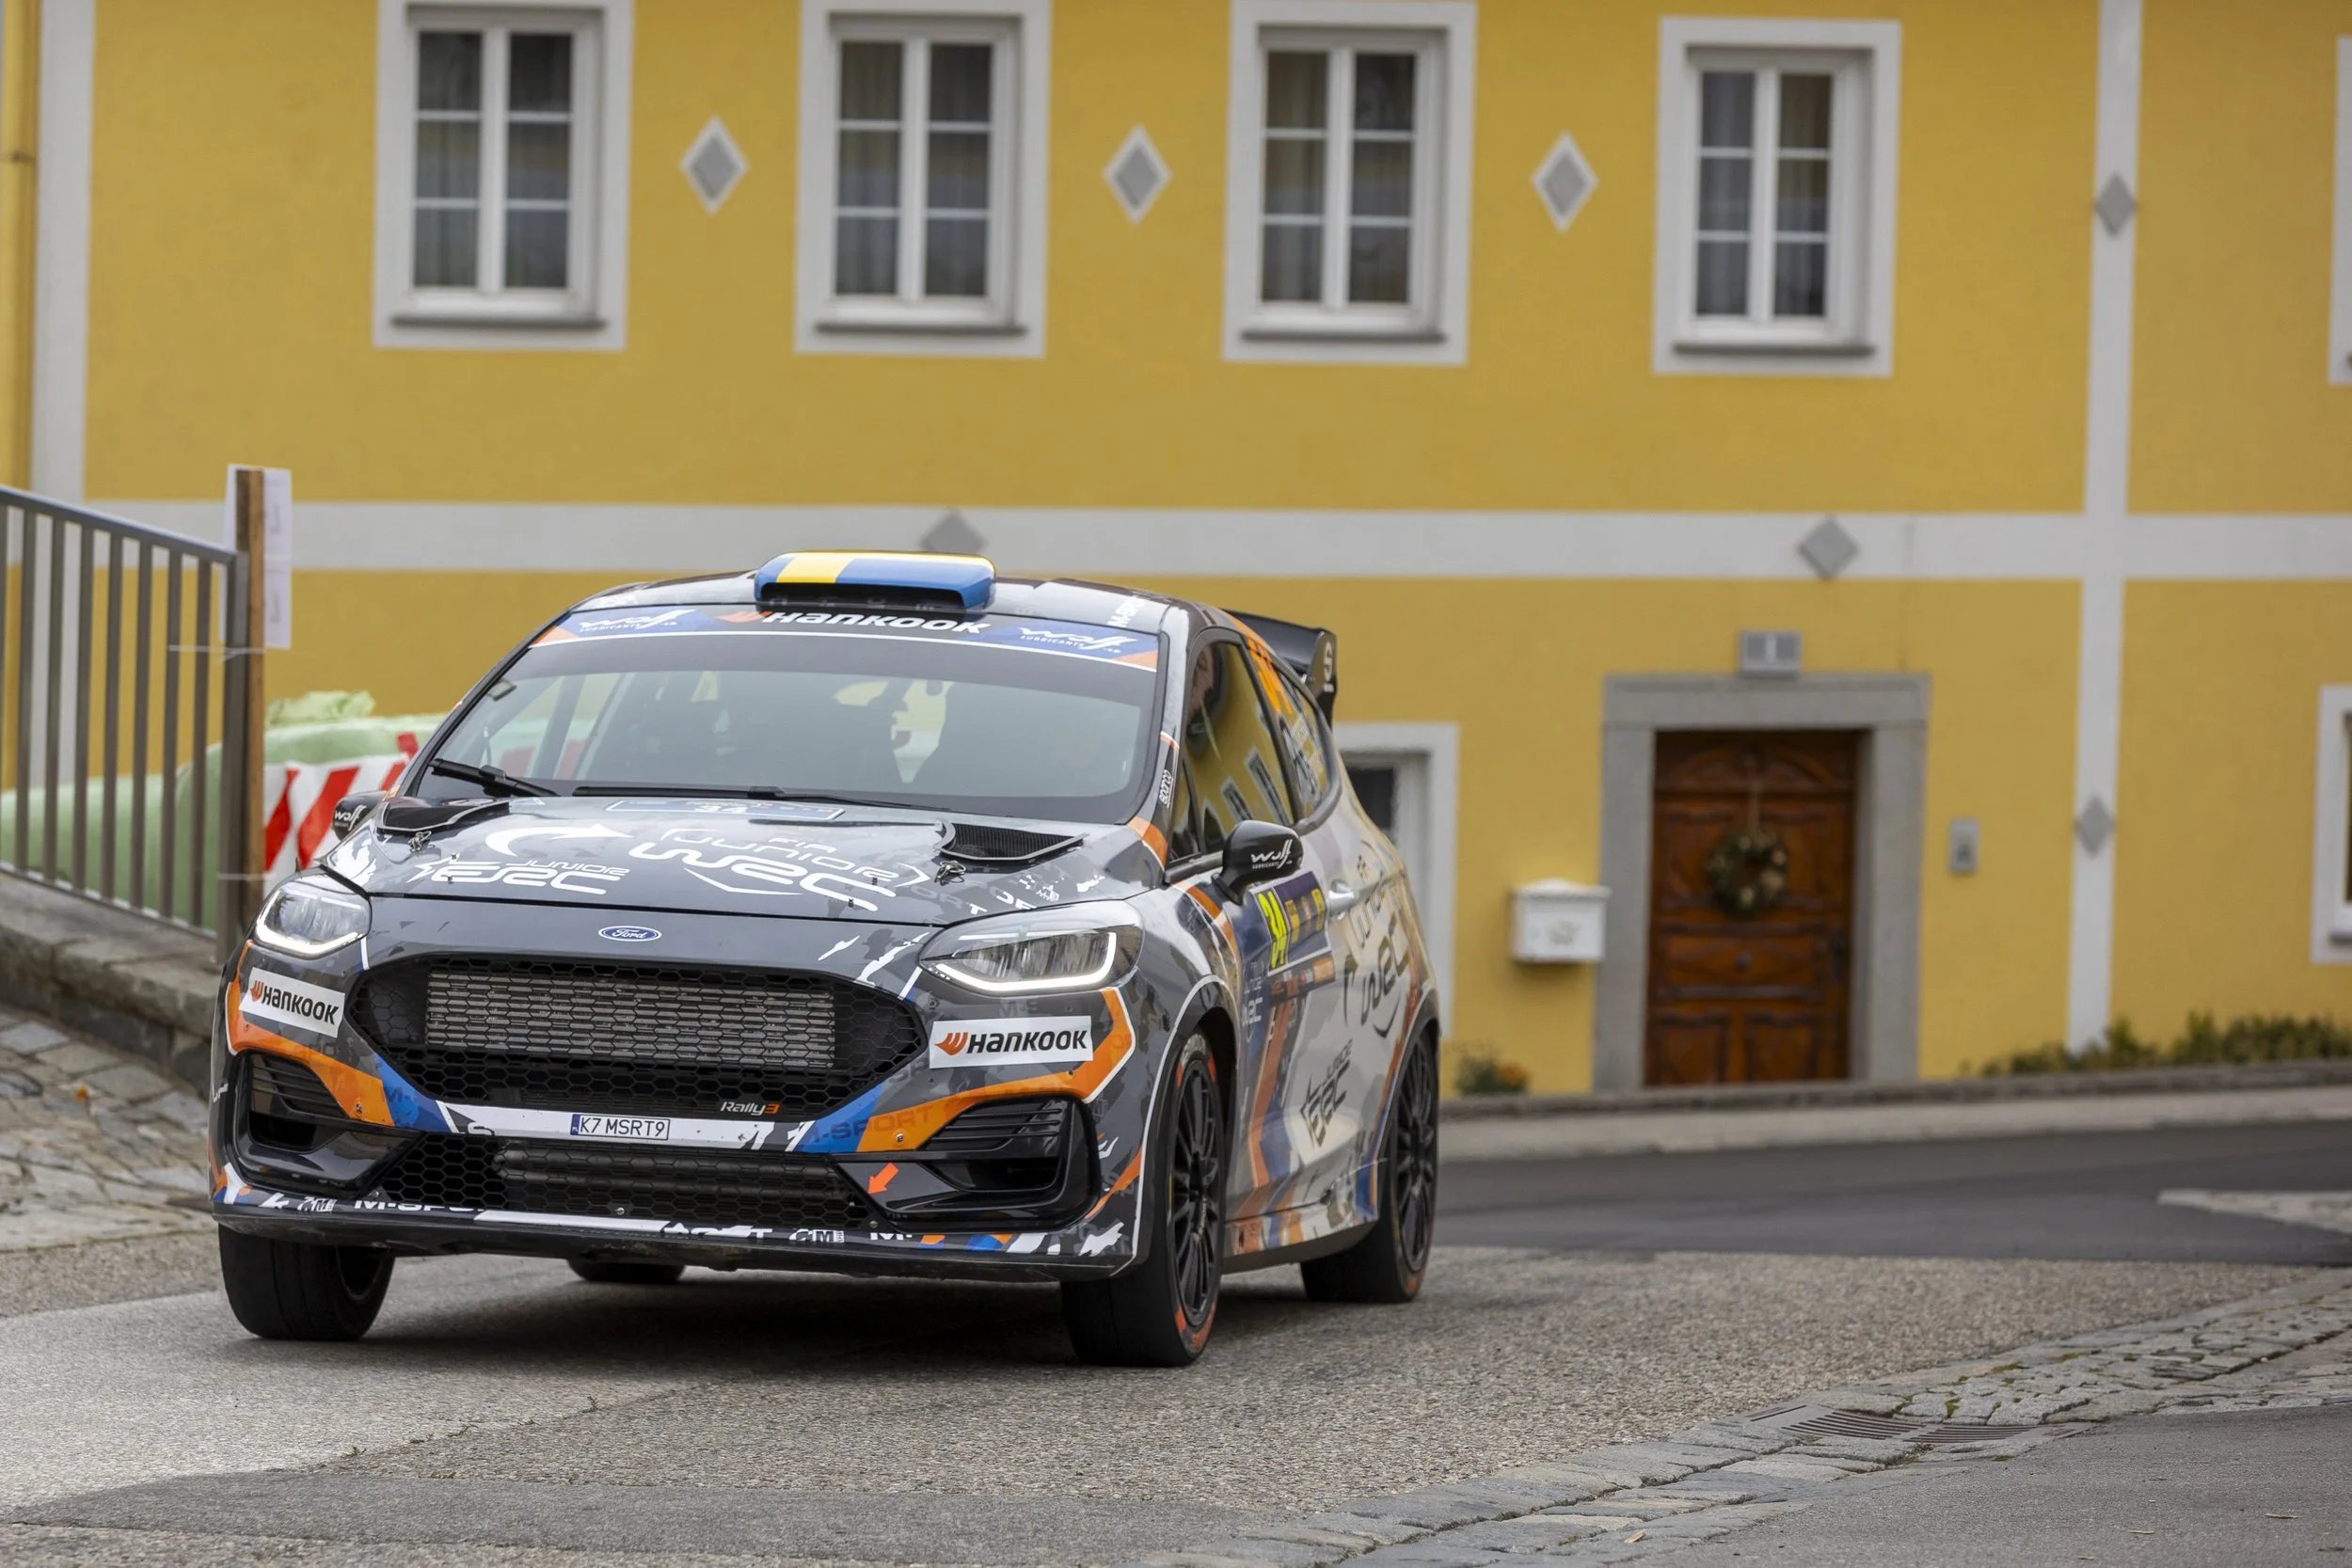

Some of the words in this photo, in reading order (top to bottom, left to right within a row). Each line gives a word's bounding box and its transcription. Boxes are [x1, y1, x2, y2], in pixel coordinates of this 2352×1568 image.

[768, 837, 837, 853] FIA
[674, 835, 899, 882] JUNIOR
[505, 859, 630, 877] JUNIOR
[628, 843, 897, 911] WRC
[612, 927, 648, 939] Ford
[720, 1101, 781, 1117] Rally3
[580, 1117, 602, 1133] K7
[605, 1118, 666, 1137] MSRT9
